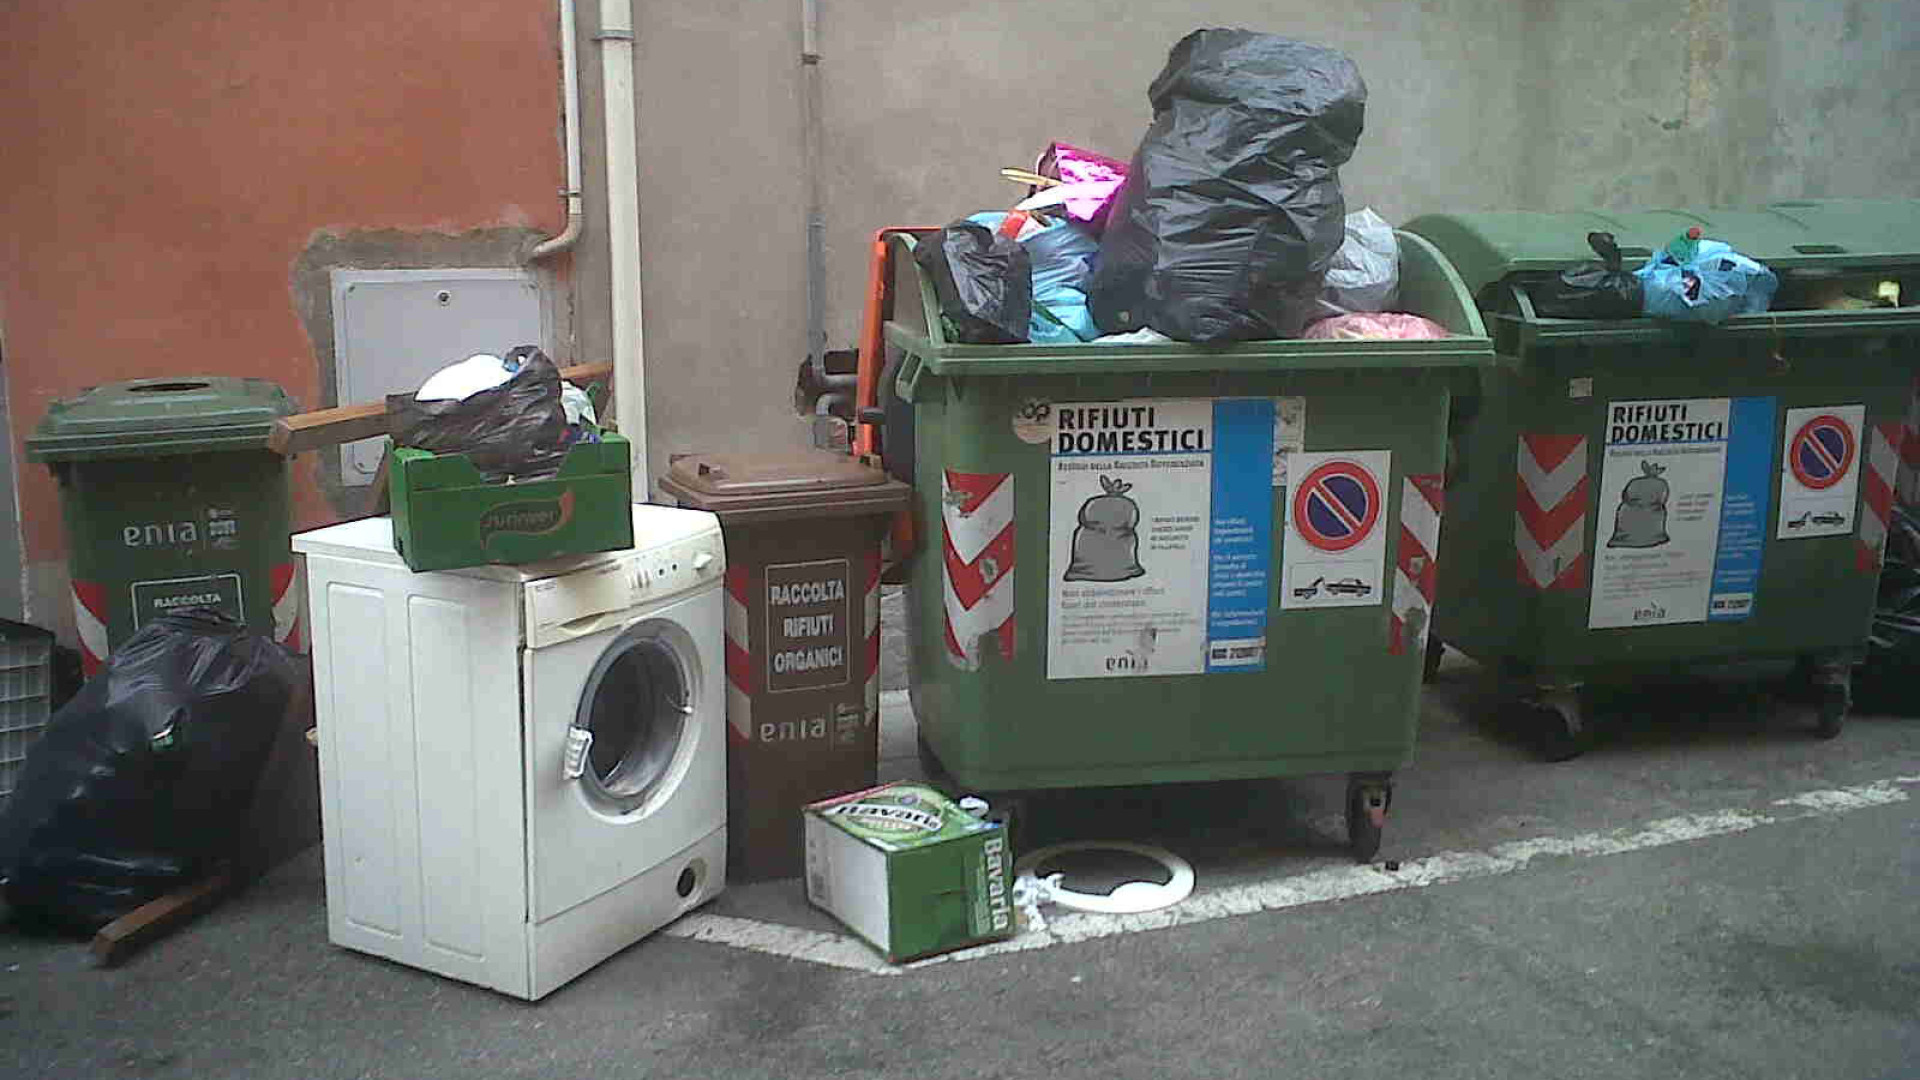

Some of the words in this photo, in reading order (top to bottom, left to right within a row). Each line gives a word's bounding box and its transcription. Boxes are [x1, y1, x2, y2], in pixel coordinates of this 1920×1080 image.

[1058, 407, 1154, 430] RIFIUTI
[1612, 403, 1688, 424] RIFIUTI
[1058, 429, 1205, 453] DOMESTICI
[1611, 422, 1723, 444] DOMESTICI
[153, 593, 222, 608] RACCOLTA
[771, 578, 845, 606] RACCOLTA
[784, 614, 835, 638] RIFIUTI
[774, 646, 844, 674] ORGANICI
